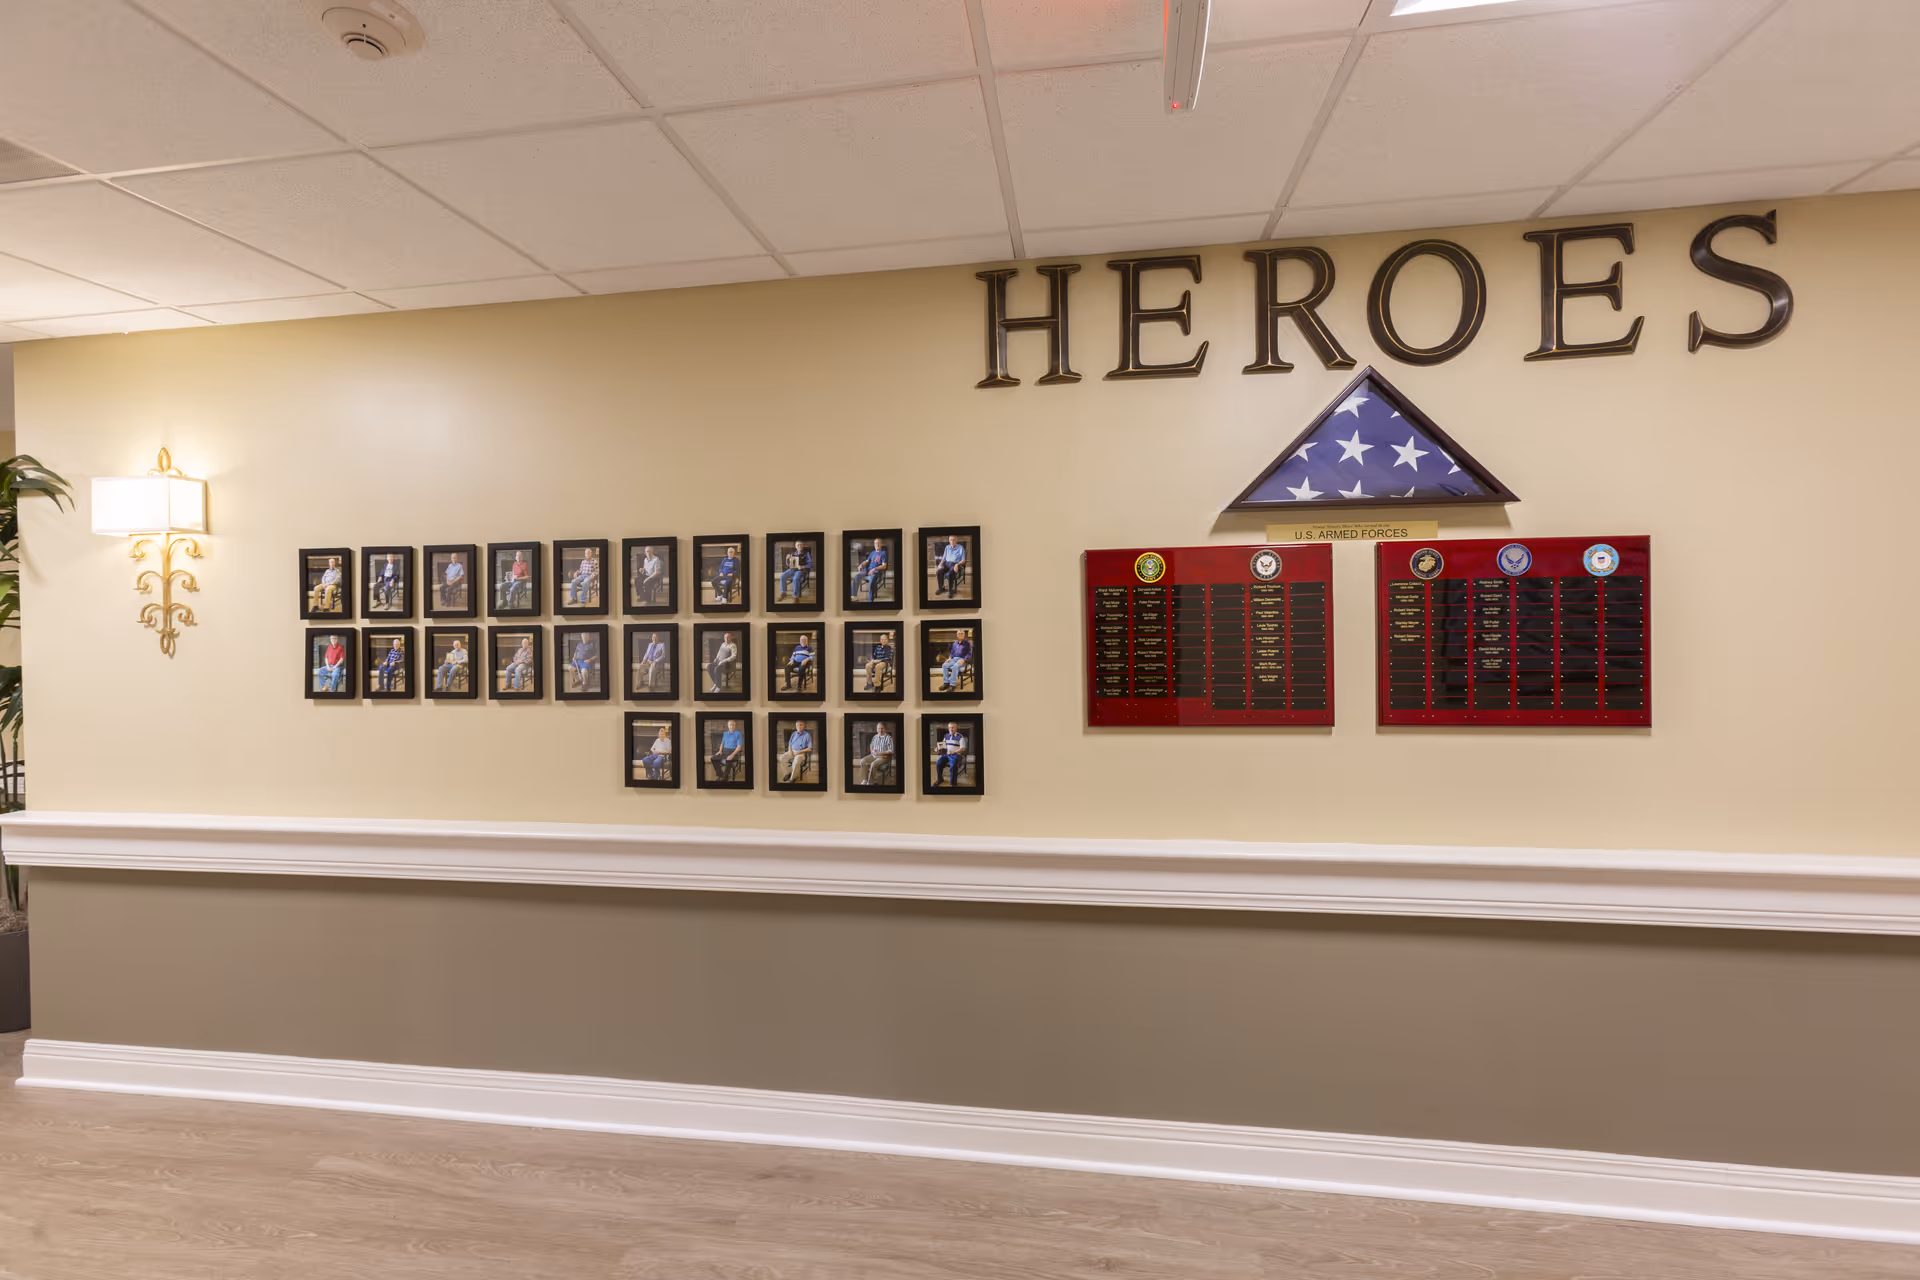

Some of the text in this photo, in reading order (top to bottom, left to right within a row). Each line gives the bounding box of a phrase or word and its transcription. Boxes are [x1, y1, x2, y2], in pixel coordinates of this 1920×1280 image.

[975, 208, 1794, 389] HEROES
[1294, 528, 1408, 540] U.S. ARMED FORCES
